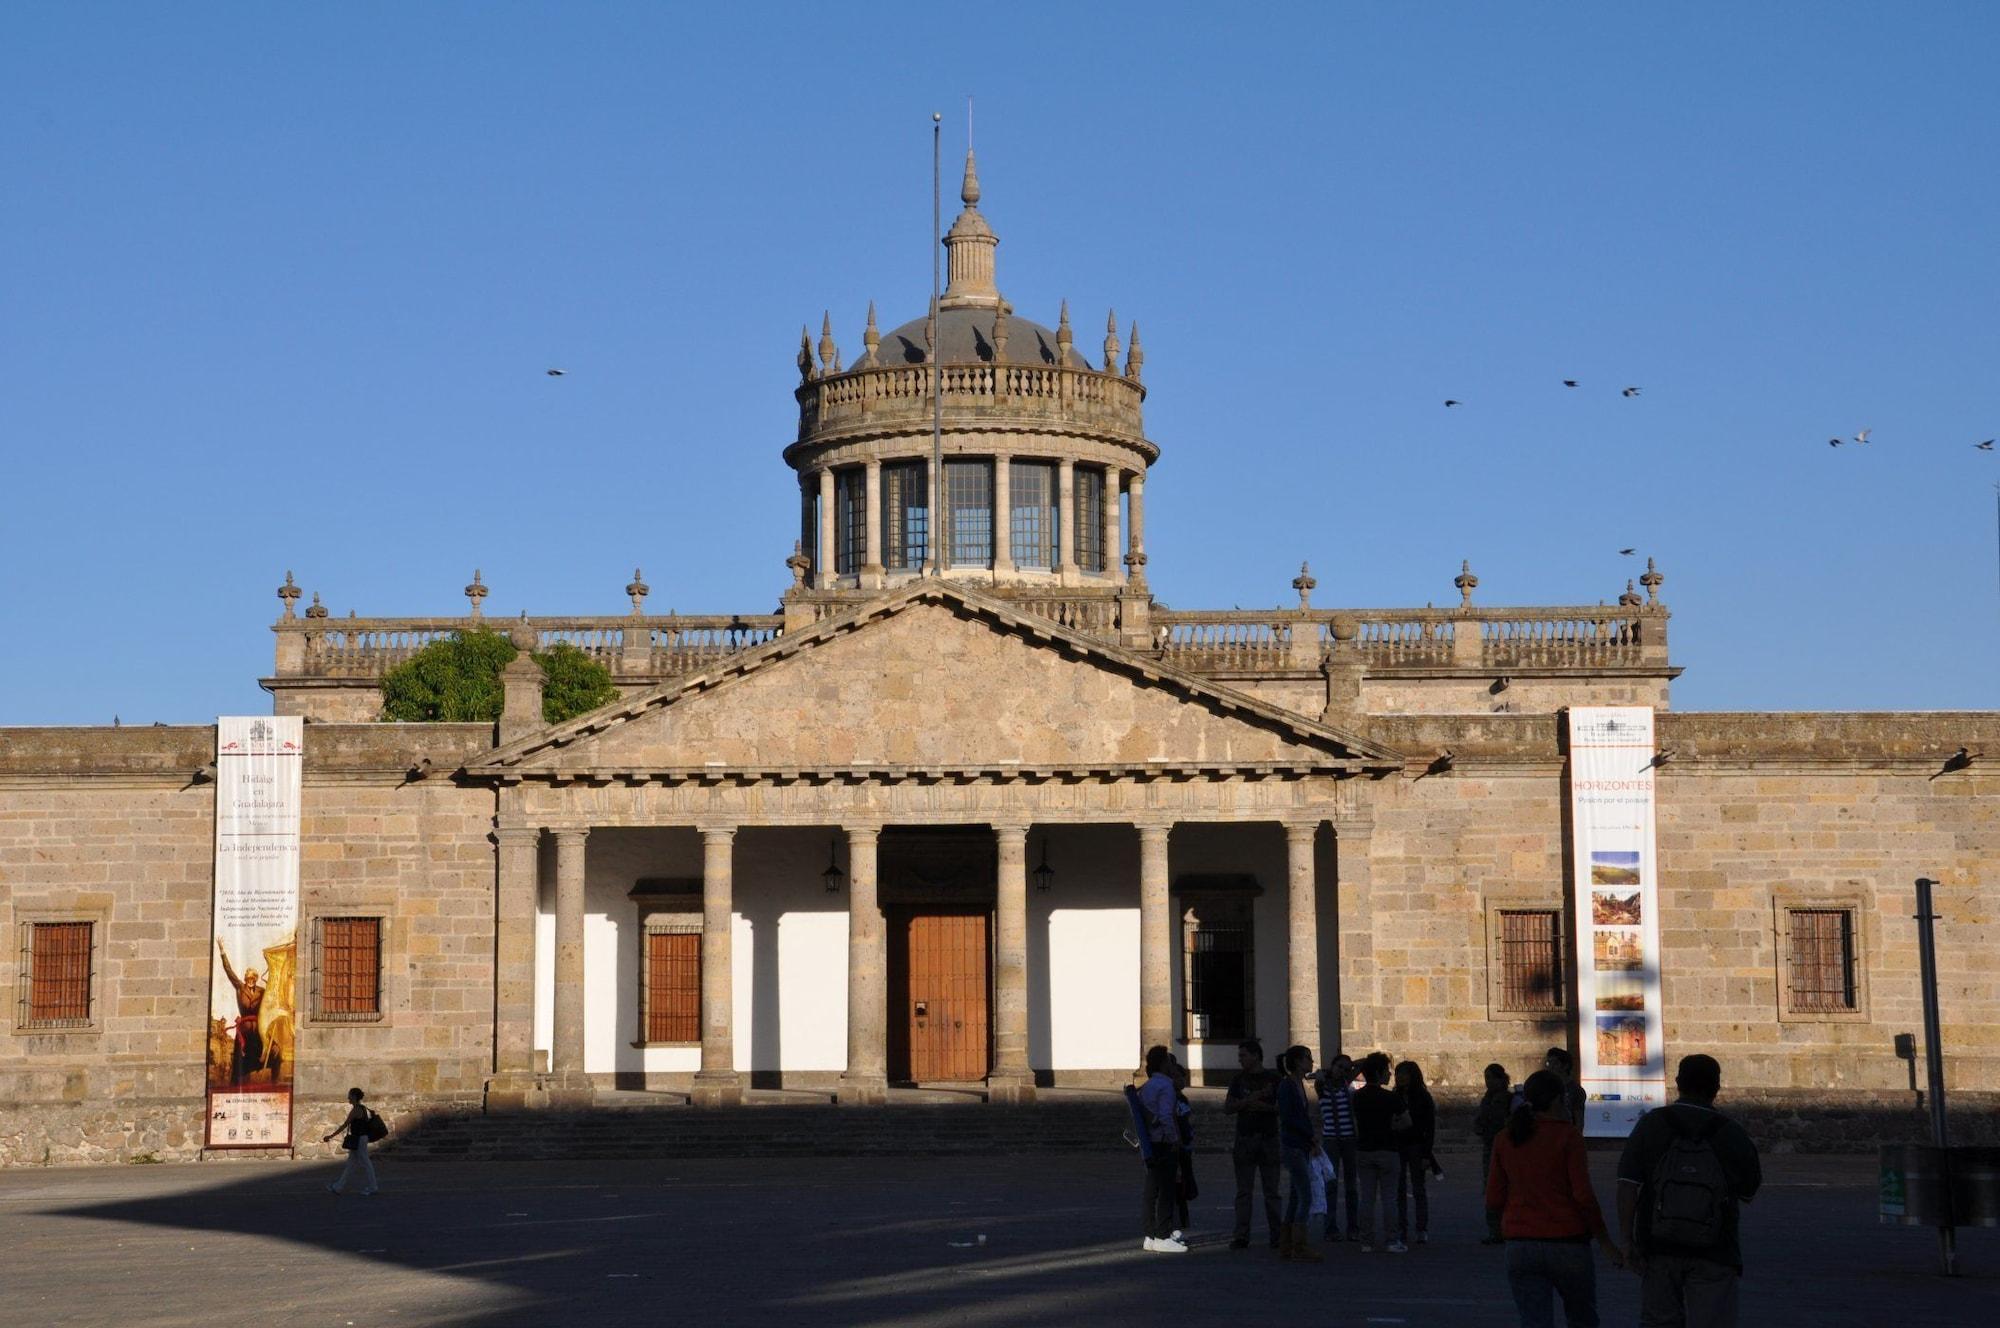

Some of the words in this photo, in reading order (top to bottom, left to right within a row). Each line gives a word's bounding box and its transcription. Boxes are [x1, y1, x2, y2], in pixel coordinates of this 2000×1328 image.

[1574, 780, 1653, 791] HORIZONTES
[233, 799, 286, 809] Guadalajara
[219, 843, 230, 852] La
[233, 842, 297, 853] Independencia
